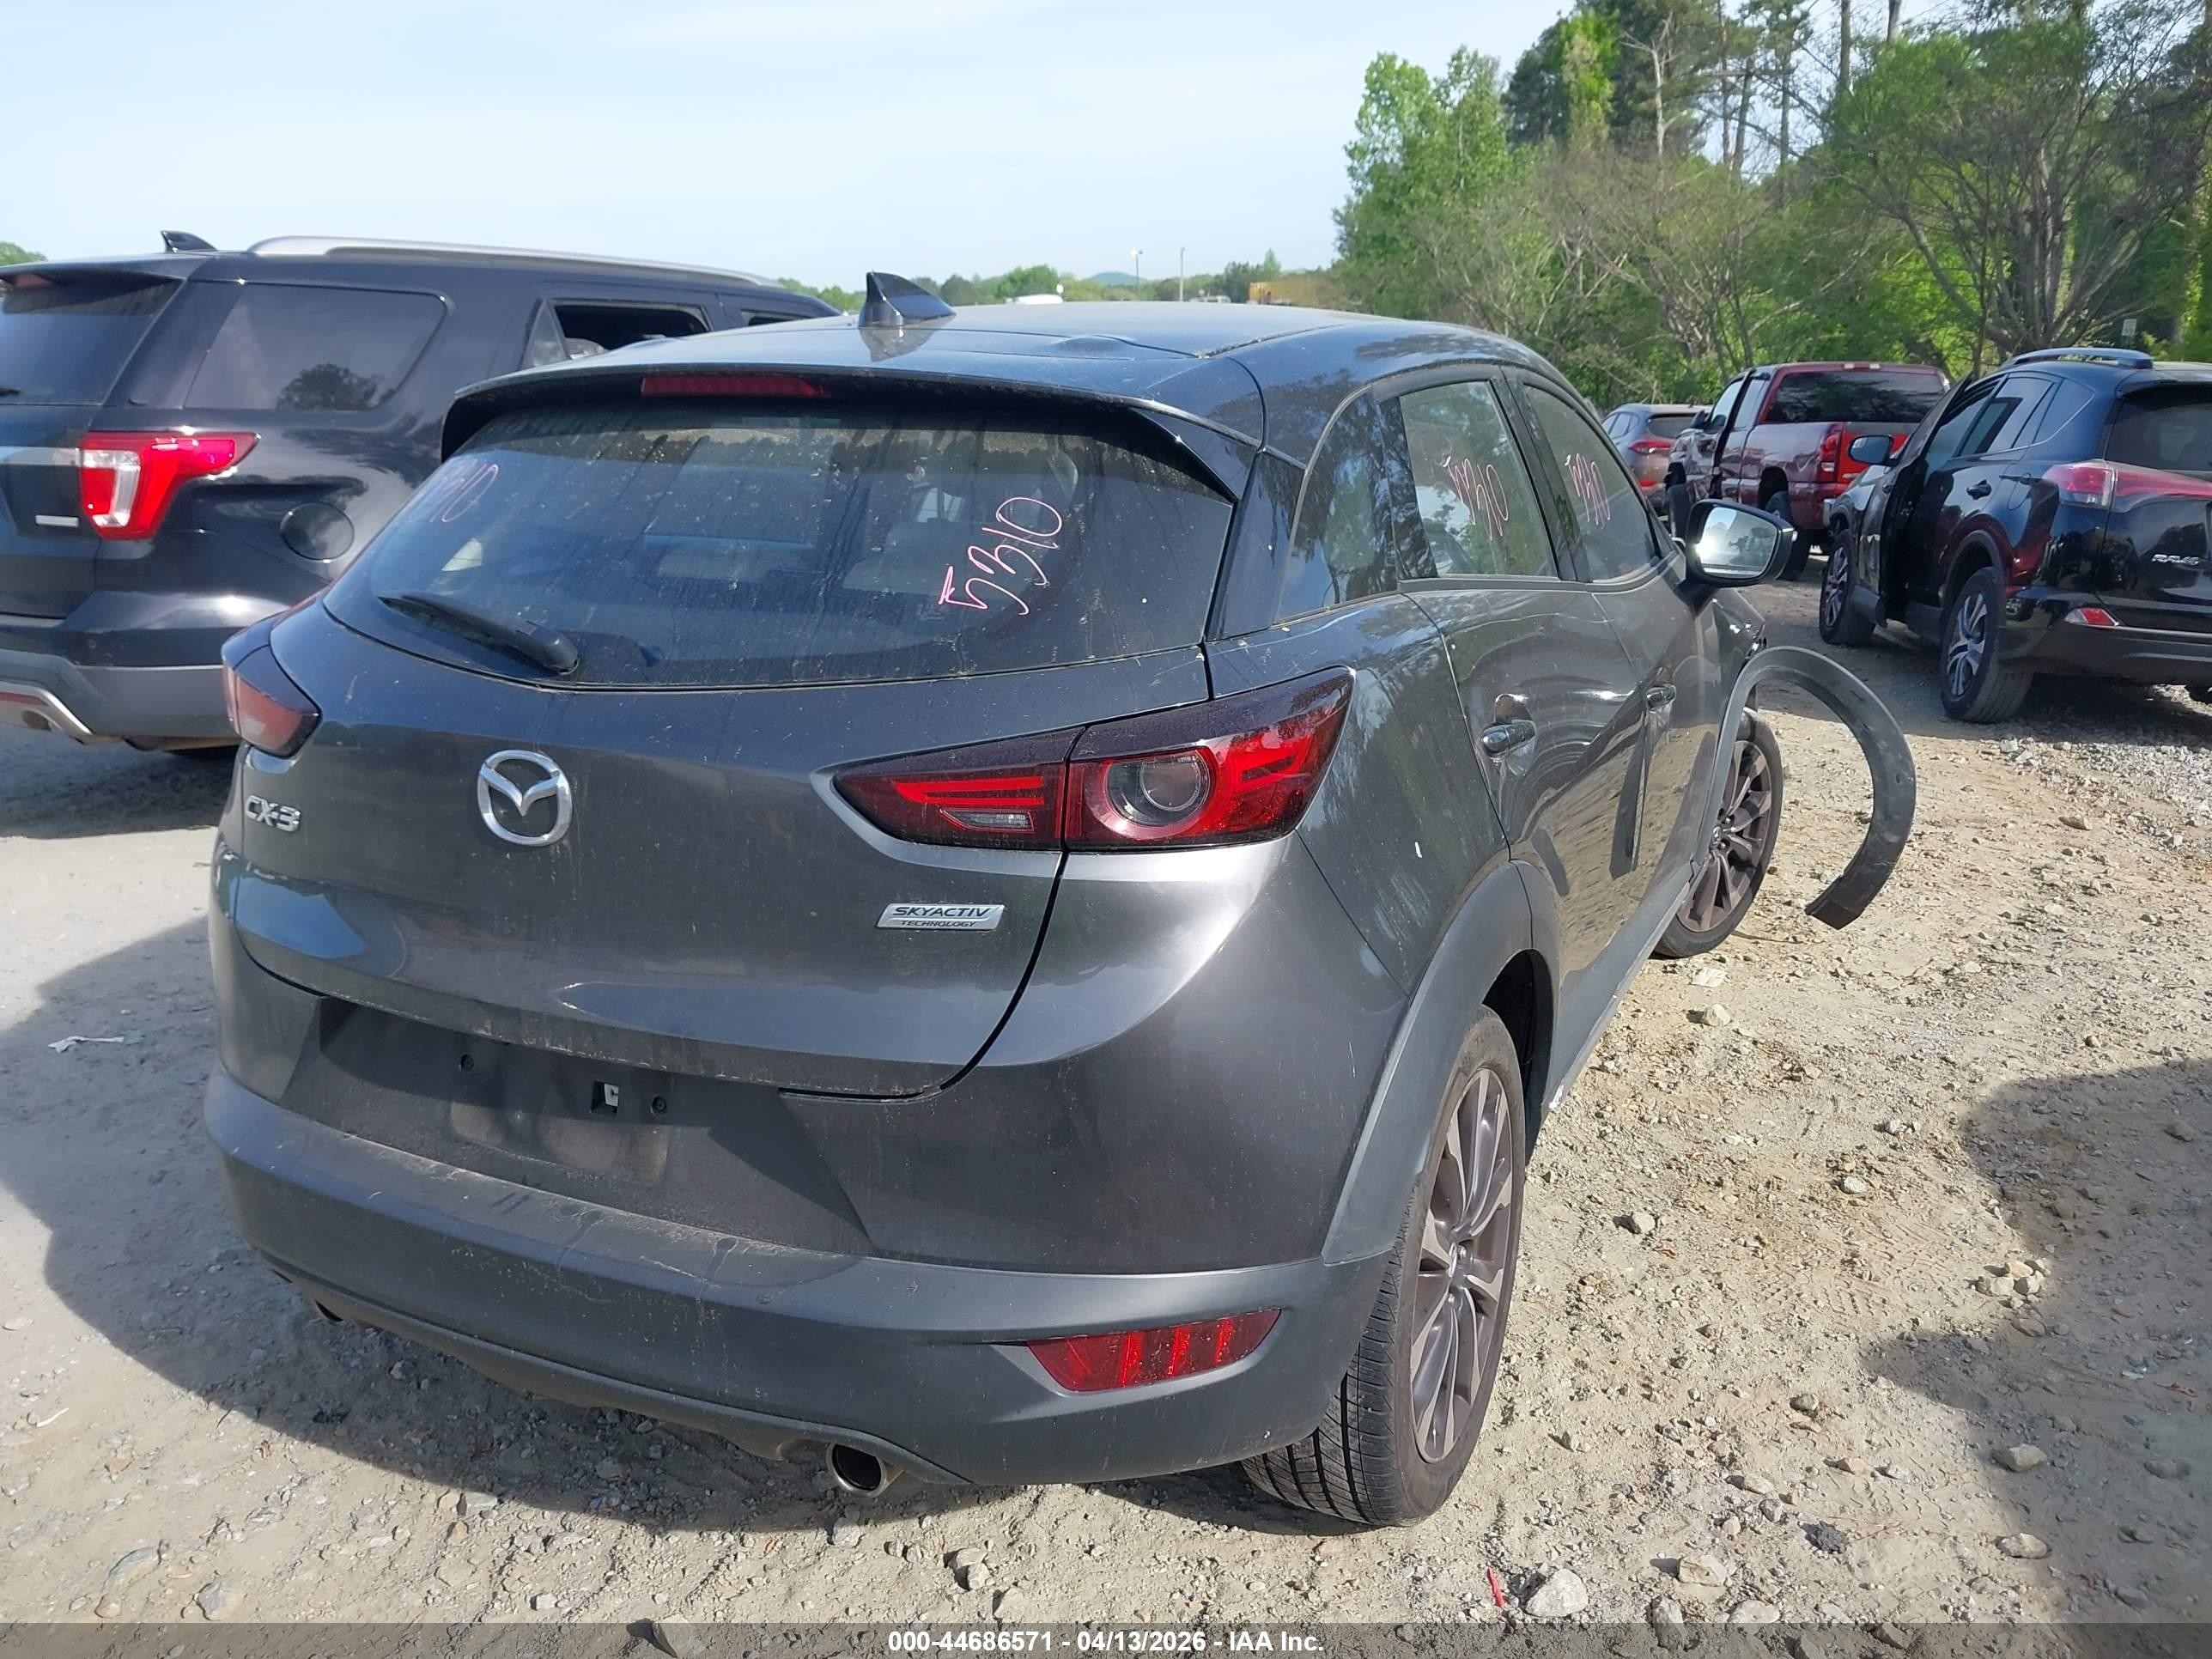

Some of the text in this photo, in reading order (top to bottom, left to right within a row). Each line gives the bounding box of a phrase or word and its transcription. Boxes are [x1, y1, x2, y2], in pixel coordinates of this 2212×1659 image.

[1442, 455, 1509, 541] 5310
[938, 496, 1062, 616] 5310
[245, 794, 301, 832] CX-3
[892, 906, 991, 917] SKYACTIV
